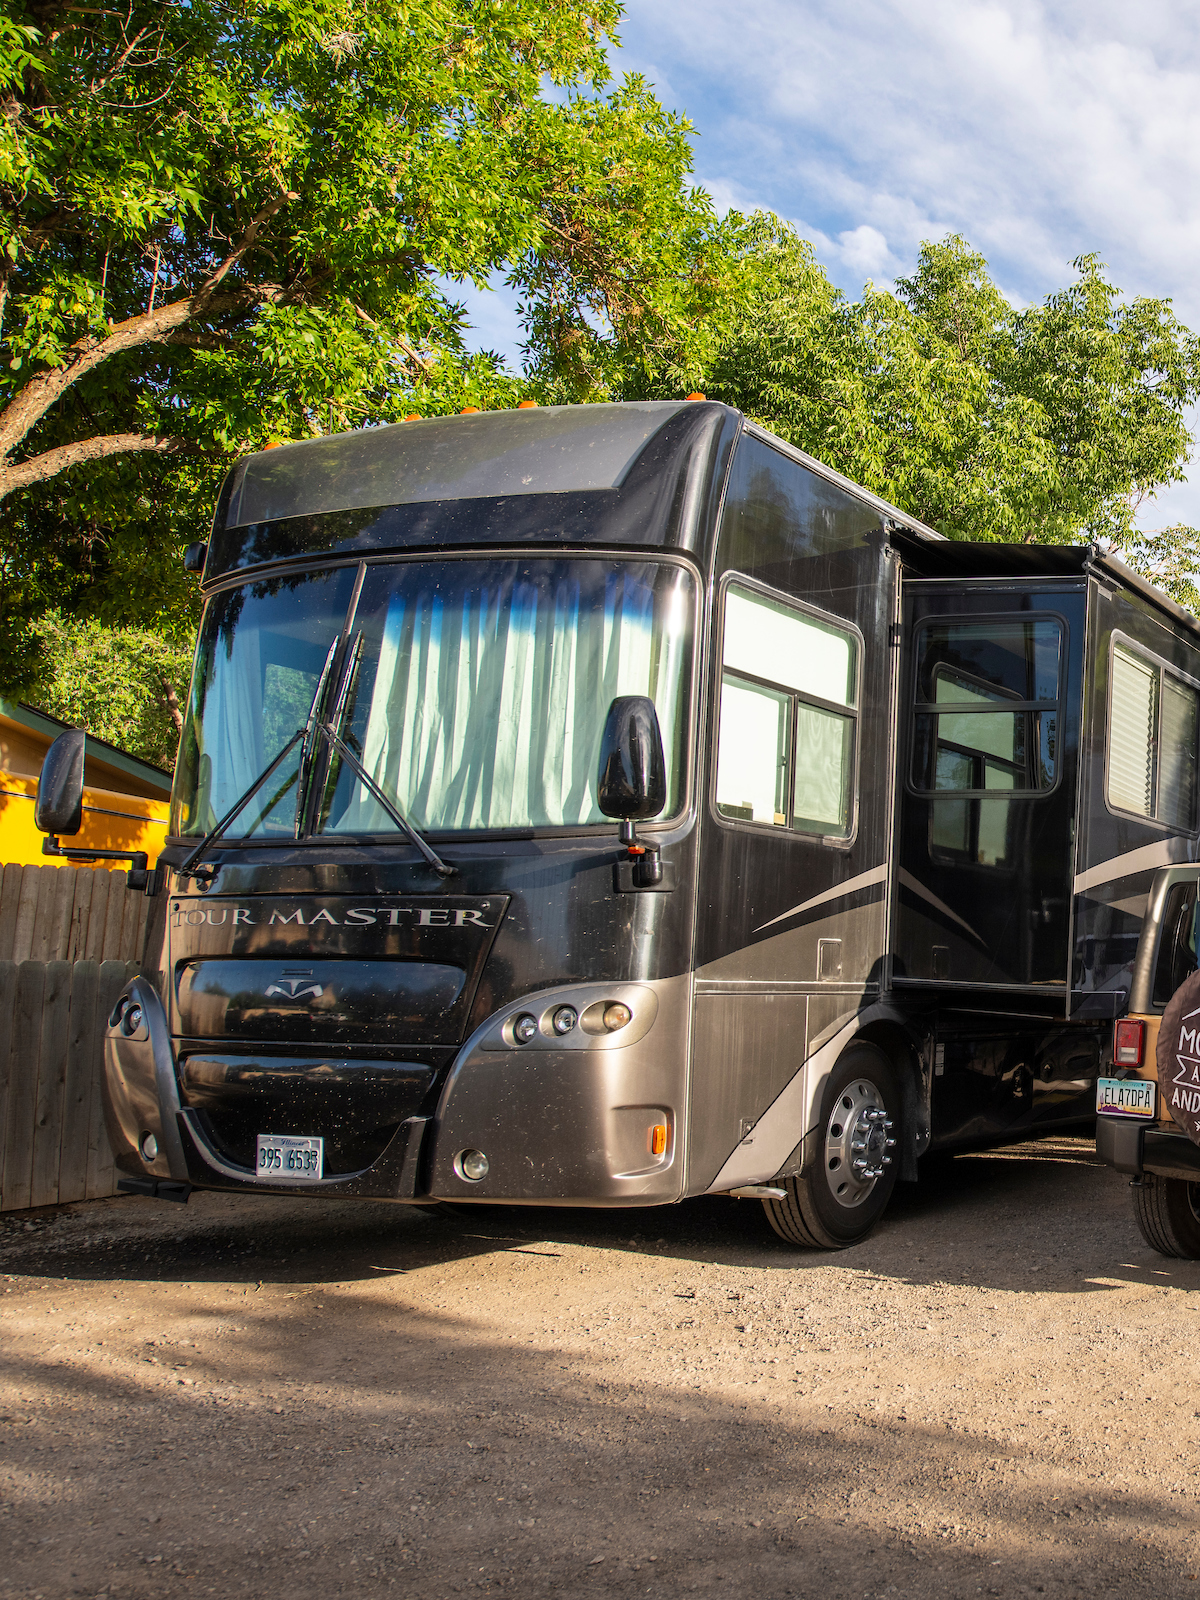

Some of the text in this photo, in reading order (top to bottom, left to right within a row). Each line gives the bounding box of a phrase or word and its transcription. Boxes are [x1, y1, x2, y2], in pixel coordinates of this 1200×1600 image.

[172, 908, 494, 928] TOUR MASTER
[1104, 1087, 1150, 1108] ELA7DPA
[260, 1147, 282, 1168] 395
